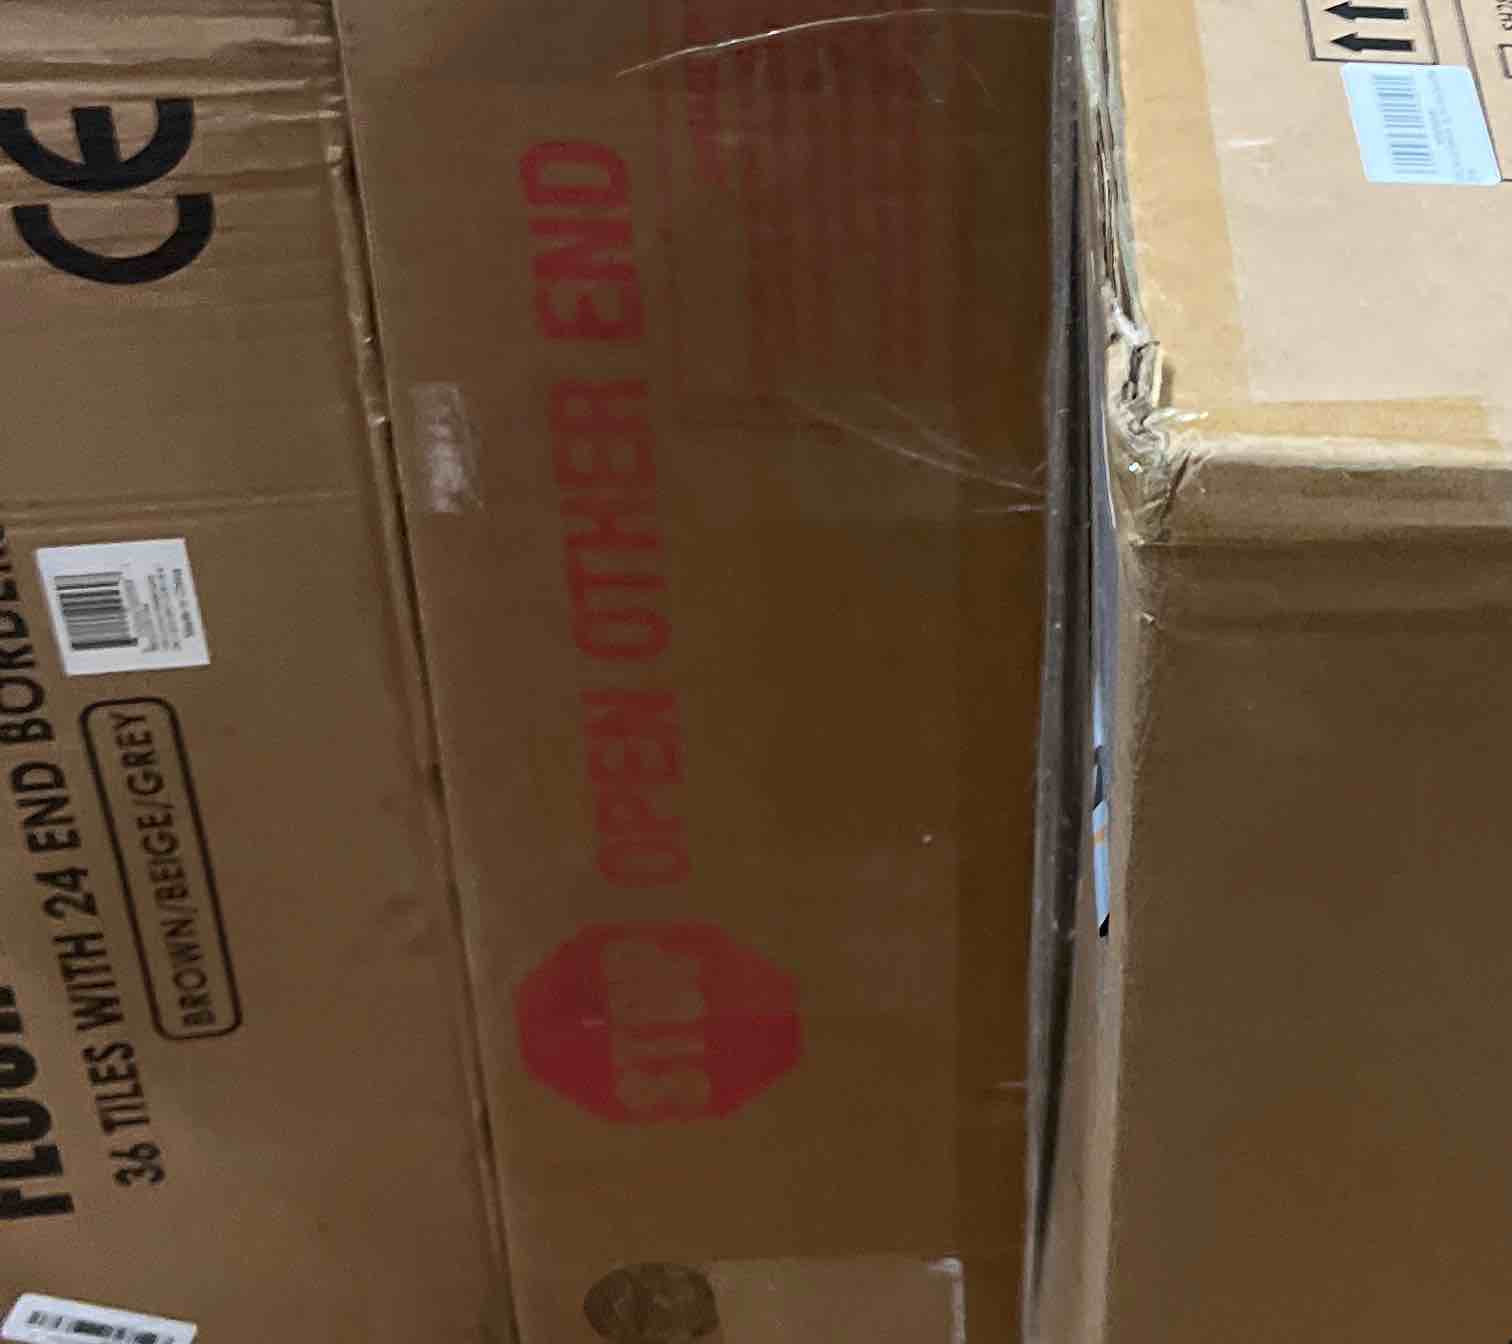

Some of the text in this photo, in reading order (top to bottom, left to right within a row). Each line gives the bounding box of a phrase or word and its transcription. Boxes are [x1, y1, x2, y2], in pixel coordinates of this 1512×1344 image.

[517, 137, 693, 891] OPEN OTHER END
[9, 760, 83, 856] END
[33, 865, 100, 921] 24
[109, 710, 218, 1030] BROWN/BEIGE/GREY
[51, 931, 125, 1033] WITH
[81, 1040, 152, 1136] TILES
[108, 1142, 167, 1189] 36
